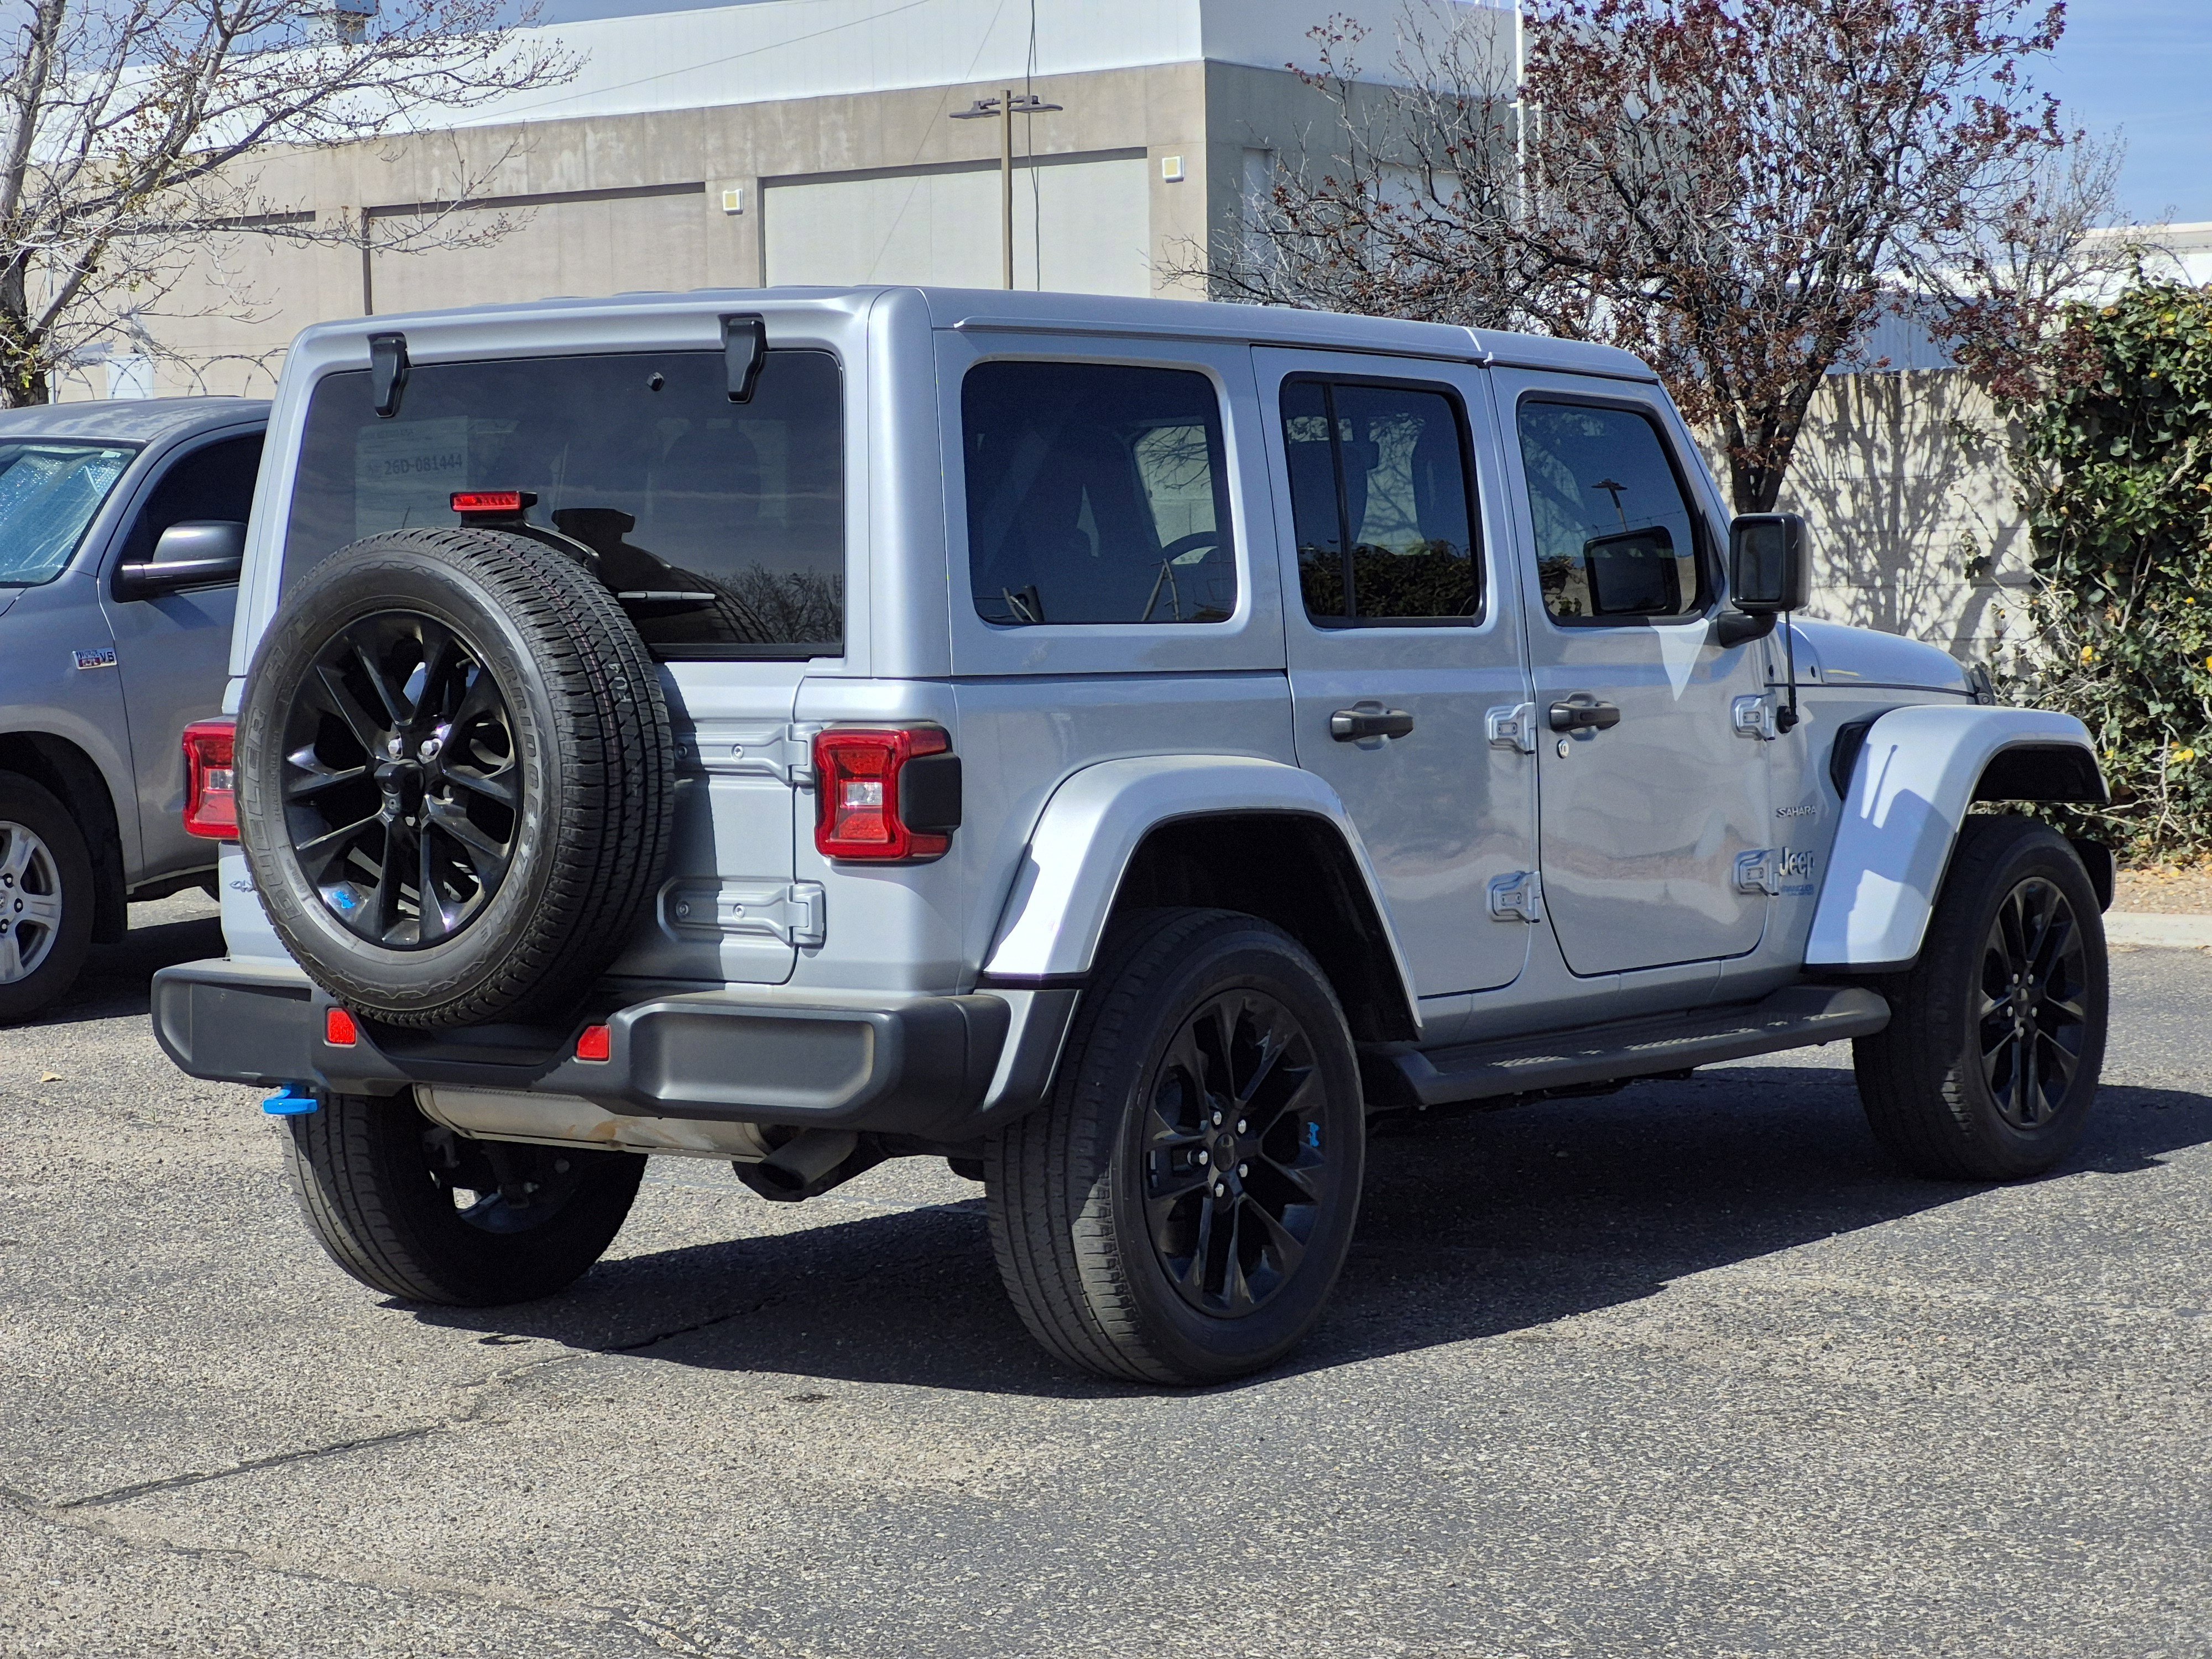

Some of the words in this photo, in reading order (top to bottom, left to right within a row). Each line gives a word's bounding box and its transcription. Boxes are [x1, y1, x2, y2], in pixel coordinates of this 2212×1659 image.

[479, 656, 539, 946] BRIDGESTONE
[1776, 805, 1817, 818] SAHARA
[1779, 846, 1815, 880] Jeep
